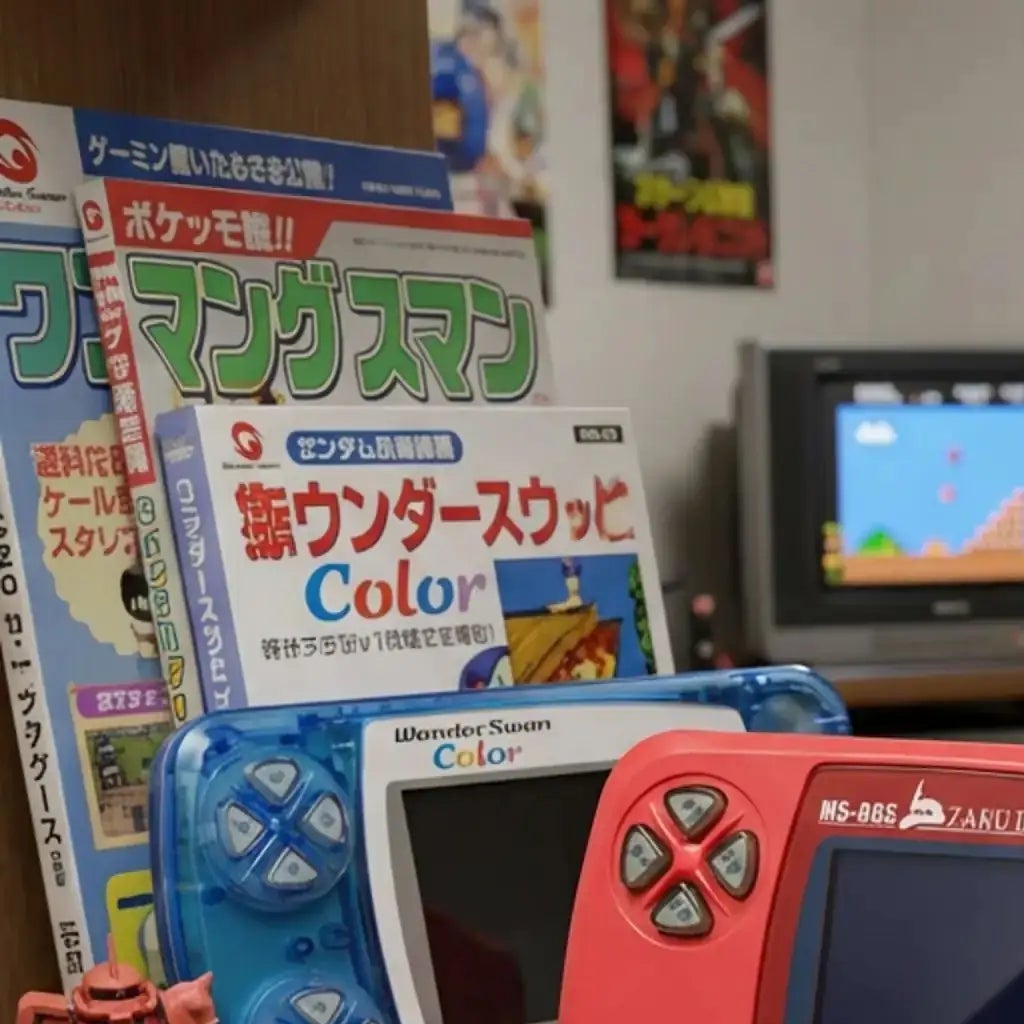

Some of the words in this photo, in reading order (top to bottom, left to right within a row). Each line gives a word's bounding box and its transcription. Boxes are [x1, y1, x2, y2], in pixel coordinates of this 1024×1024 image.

[126, 252, 540, 404] マングスマン
[305, 558, 487, 622] Color
[433, 740, 523, 769] Color
